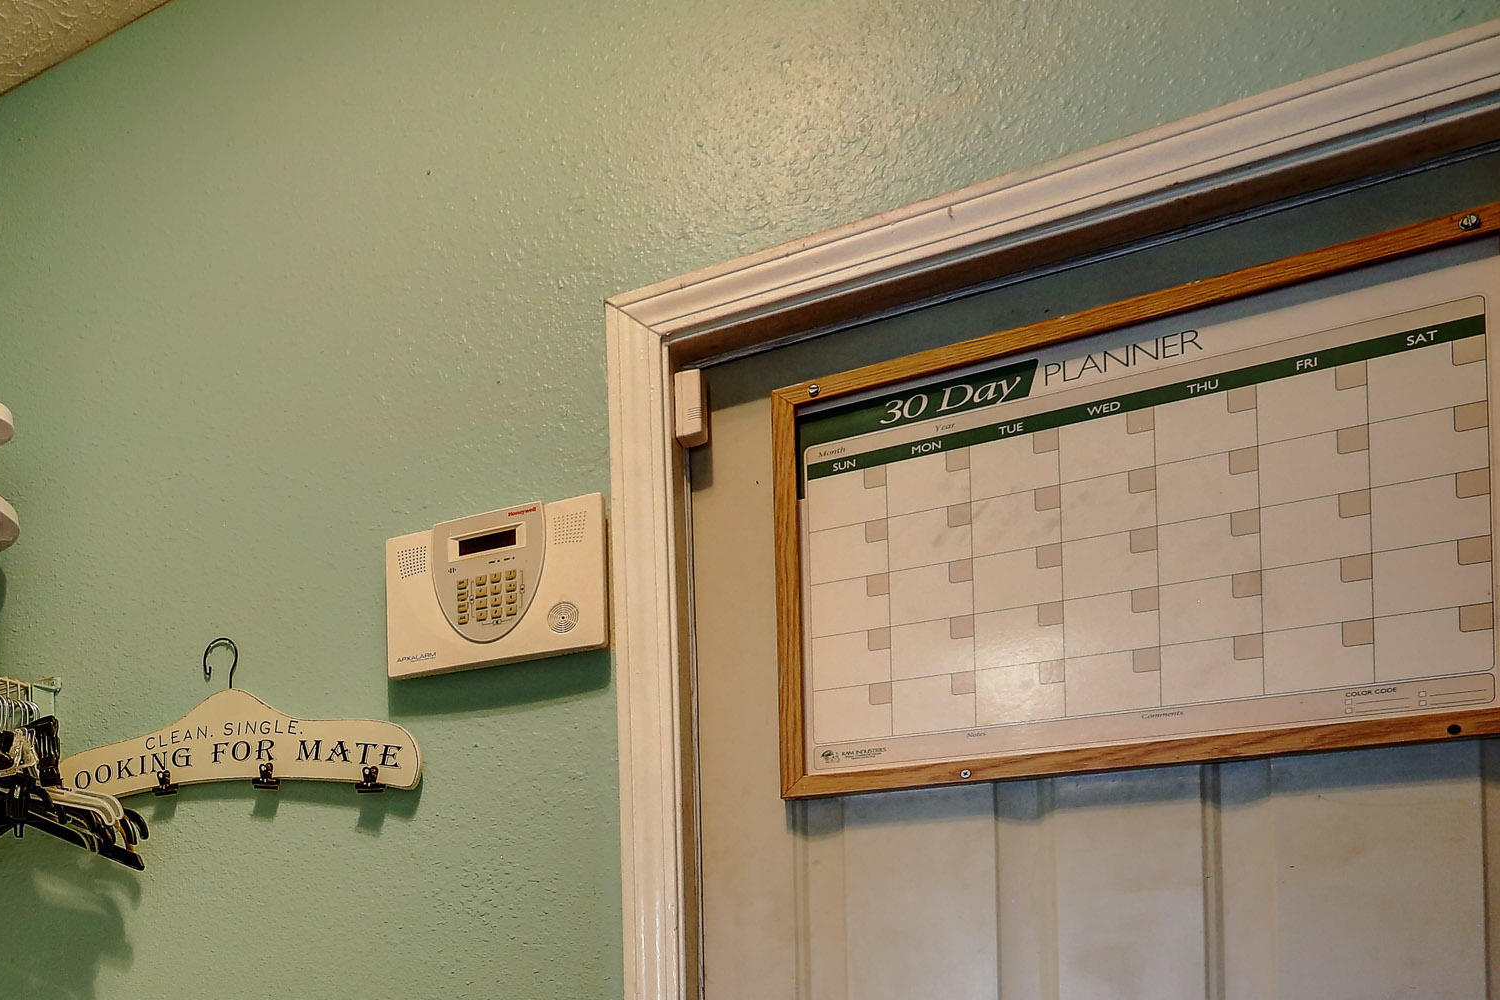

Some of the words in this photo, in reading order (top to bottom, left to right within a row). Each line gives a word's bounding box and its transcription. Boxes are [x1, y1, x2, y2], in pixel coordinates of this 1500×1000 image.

[879, 393, 929, 426] 30
[936, 374, 1022, 413] Day
[1044, 329, 1204, 387] PLANNER
[832, 458, 857, 472] SUN
[911, 440, 942, 455] MON
[998, 422, 1023, 436] TUE
[1086, 400, 1121, 417] WED
[1186, 379, 1219, 395] THU
[1295, 357, 1318, 372] FRI
[1405, 329, 1438, 347] SAT
[817, 446, 847, 458] Month
[934, 421, 956, 433] Year
[507, 506, 537, 517] Honeywell
[1345, 688, 1373, 698] COLOR
[1374, 687, 1397, 695] CODE
[1141, 710, 1184, 719] Comments
[144, 725, 214, 751] CLEAN.
[222, 719, 304, 737] SINGLE.
[68, 748, 193, 792] OOKING
[211, 738, 275, 765] FOR
[296, 739, 403, 770] MATE
